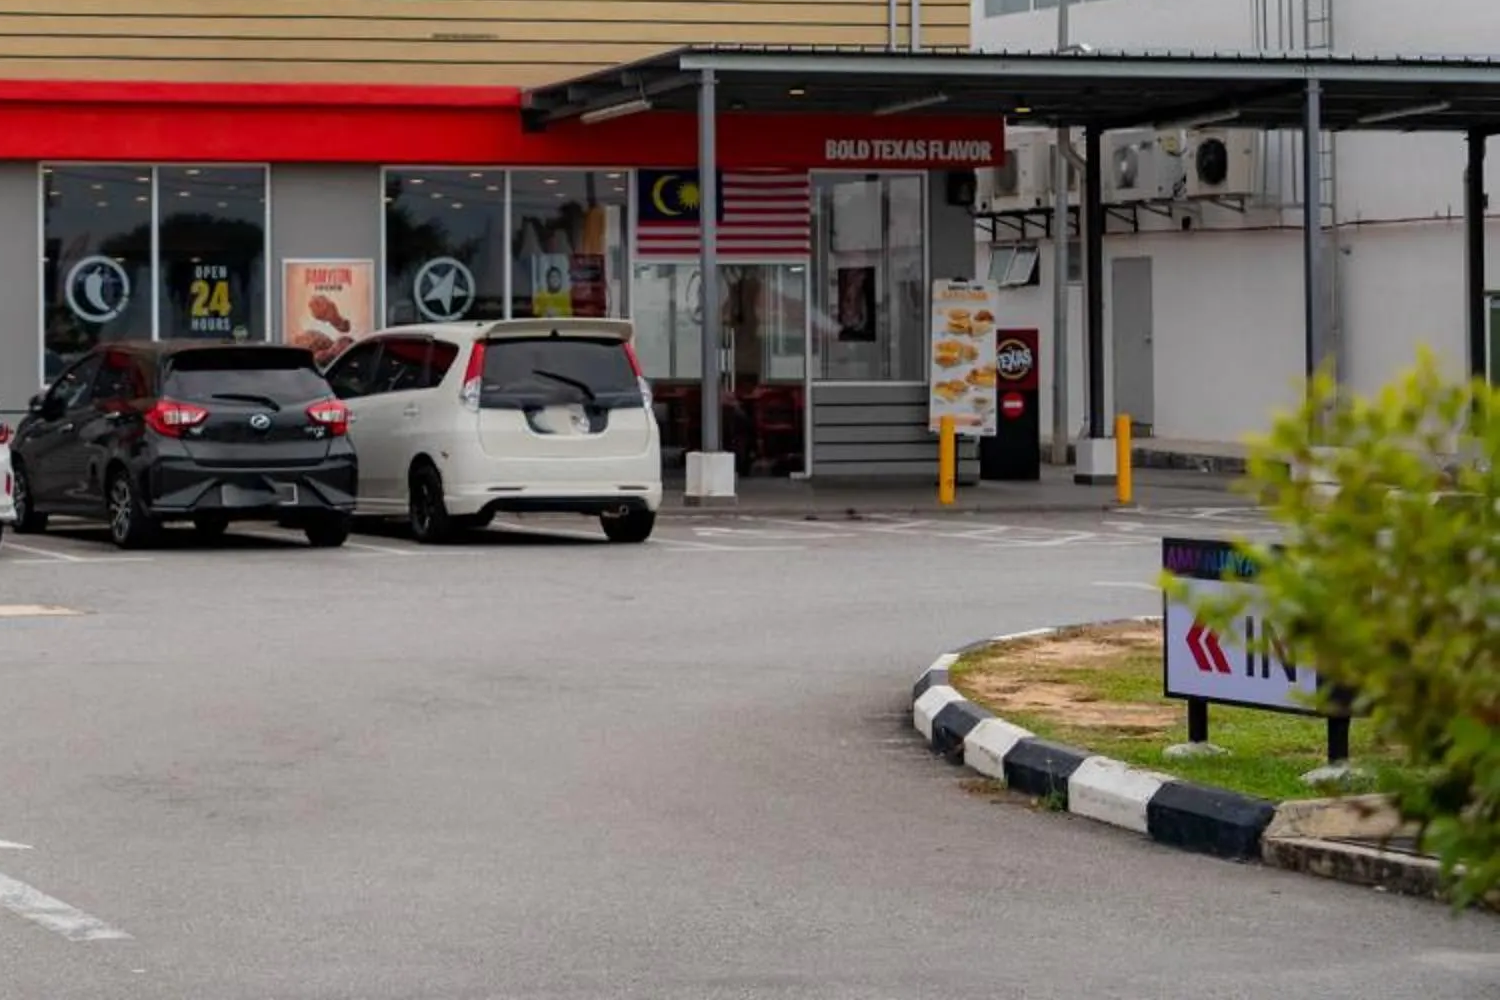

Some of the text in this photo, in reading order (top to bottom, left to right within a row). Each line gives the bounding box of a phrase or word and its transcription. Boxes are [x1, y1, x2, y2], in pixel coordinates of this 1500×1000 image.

[825, 138, 992, 161] BOLD TEXAS FLAVOR
[195, 265, 228, 279] OPEN
[190, 280, 232, 317] 24
[191, 317, 231, 331] HOURS
